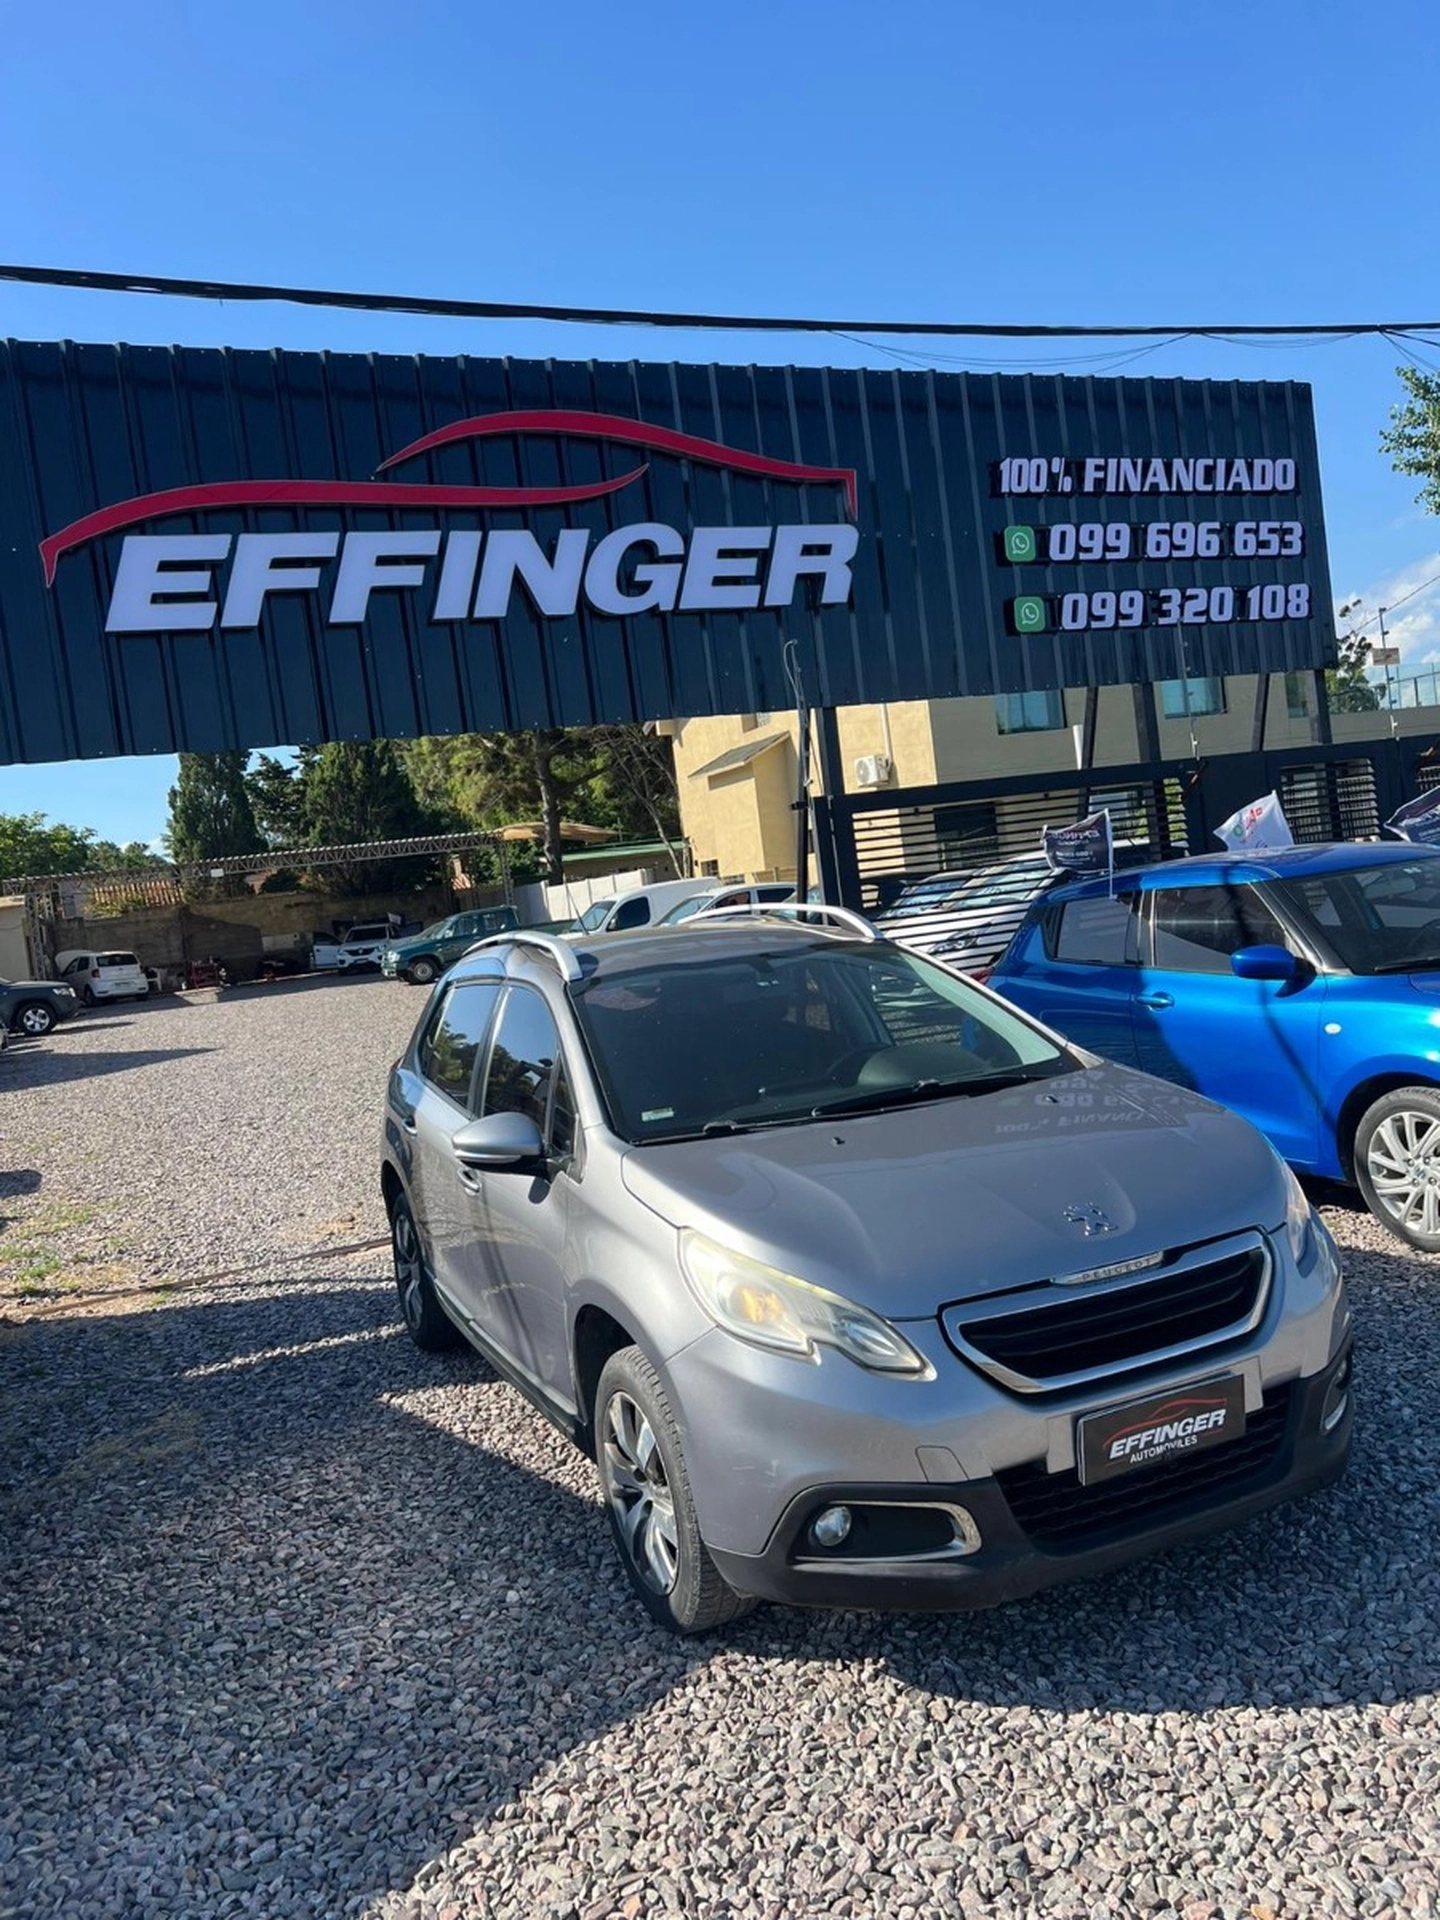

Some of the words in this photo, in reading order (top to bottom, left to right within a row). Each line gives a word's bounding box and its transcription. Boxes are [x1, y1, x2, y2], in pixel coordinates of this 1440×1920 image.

[1000, 457, 1072, 494] 100%
[1084, 458, 1296, 493] FINANCIADO
[1049, 523, 1131, 561] 099
[1147, 522, 1221, 558] 696
[1234, 521, 1303, 556] 653
[104, 522, 858, 632] EFFINGER
[1061, 591, 1144, 630] 099
[1159, 587, 1234, 626] 320
[1249, 583, 1309, 621] 108
[1082, 1257, 1152, 1282] PEUGEOT
[1109, 1408, 1228, 1460] EFFINGER
[1129, 1434, 1199, 1464] AUTOMOVILES
